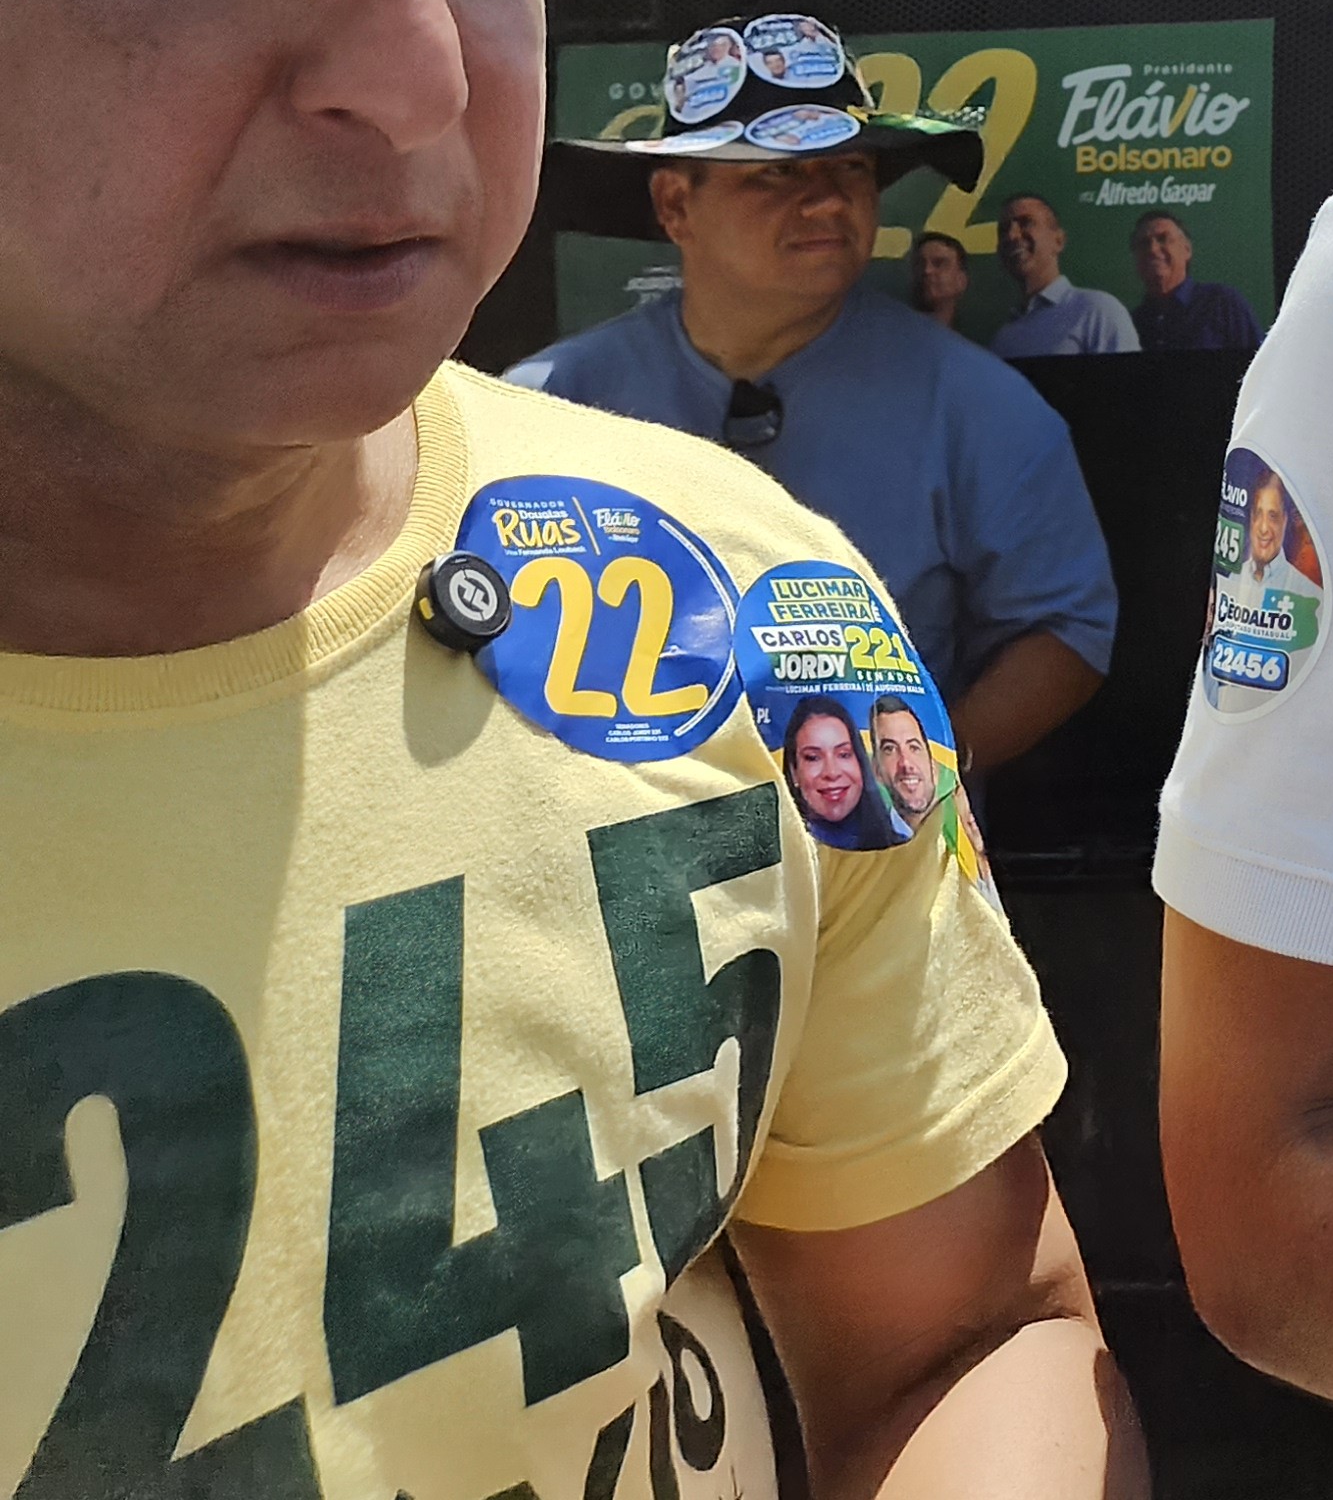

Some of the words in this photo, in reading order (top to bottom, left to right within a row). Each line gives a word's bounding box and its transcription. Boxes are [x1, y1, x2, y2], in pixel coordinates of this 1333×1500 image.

[1143, 62, 1233, 76] Presidente
[1058, 63, 1250, 148] Flávio
[1076, 143, 1233, 173] Bolsonaro
[1096, 178, 1159, 206] Alfredo
[1160, 175, 1216, 206] Gaspar
[489, 497, 565, 509] GOVERNADOR
[518, 509, 568, 520] Douglas
[491, 508, 581, 548] Ruas
[775, 580, 865, 599] LUCIMAR
[773, 603, 871, 620] FERREIRA
[511, 556, 709, 718] 22
[761, 629, 842, 647] CARLOS
[1251, 627, 1290, 640] ESTADUAL
[844, 625, 918, 674] 221
[774, 653, 848, 680] JORDY
[1213, 644, 1281, 682] 22456
[857, 669, 922, 685] SENADOR
[785, 684, 821, 694] LUCIMAR
[823, 683, 861, 693] FERREIRA
[756, 708, 771, 724] PL
